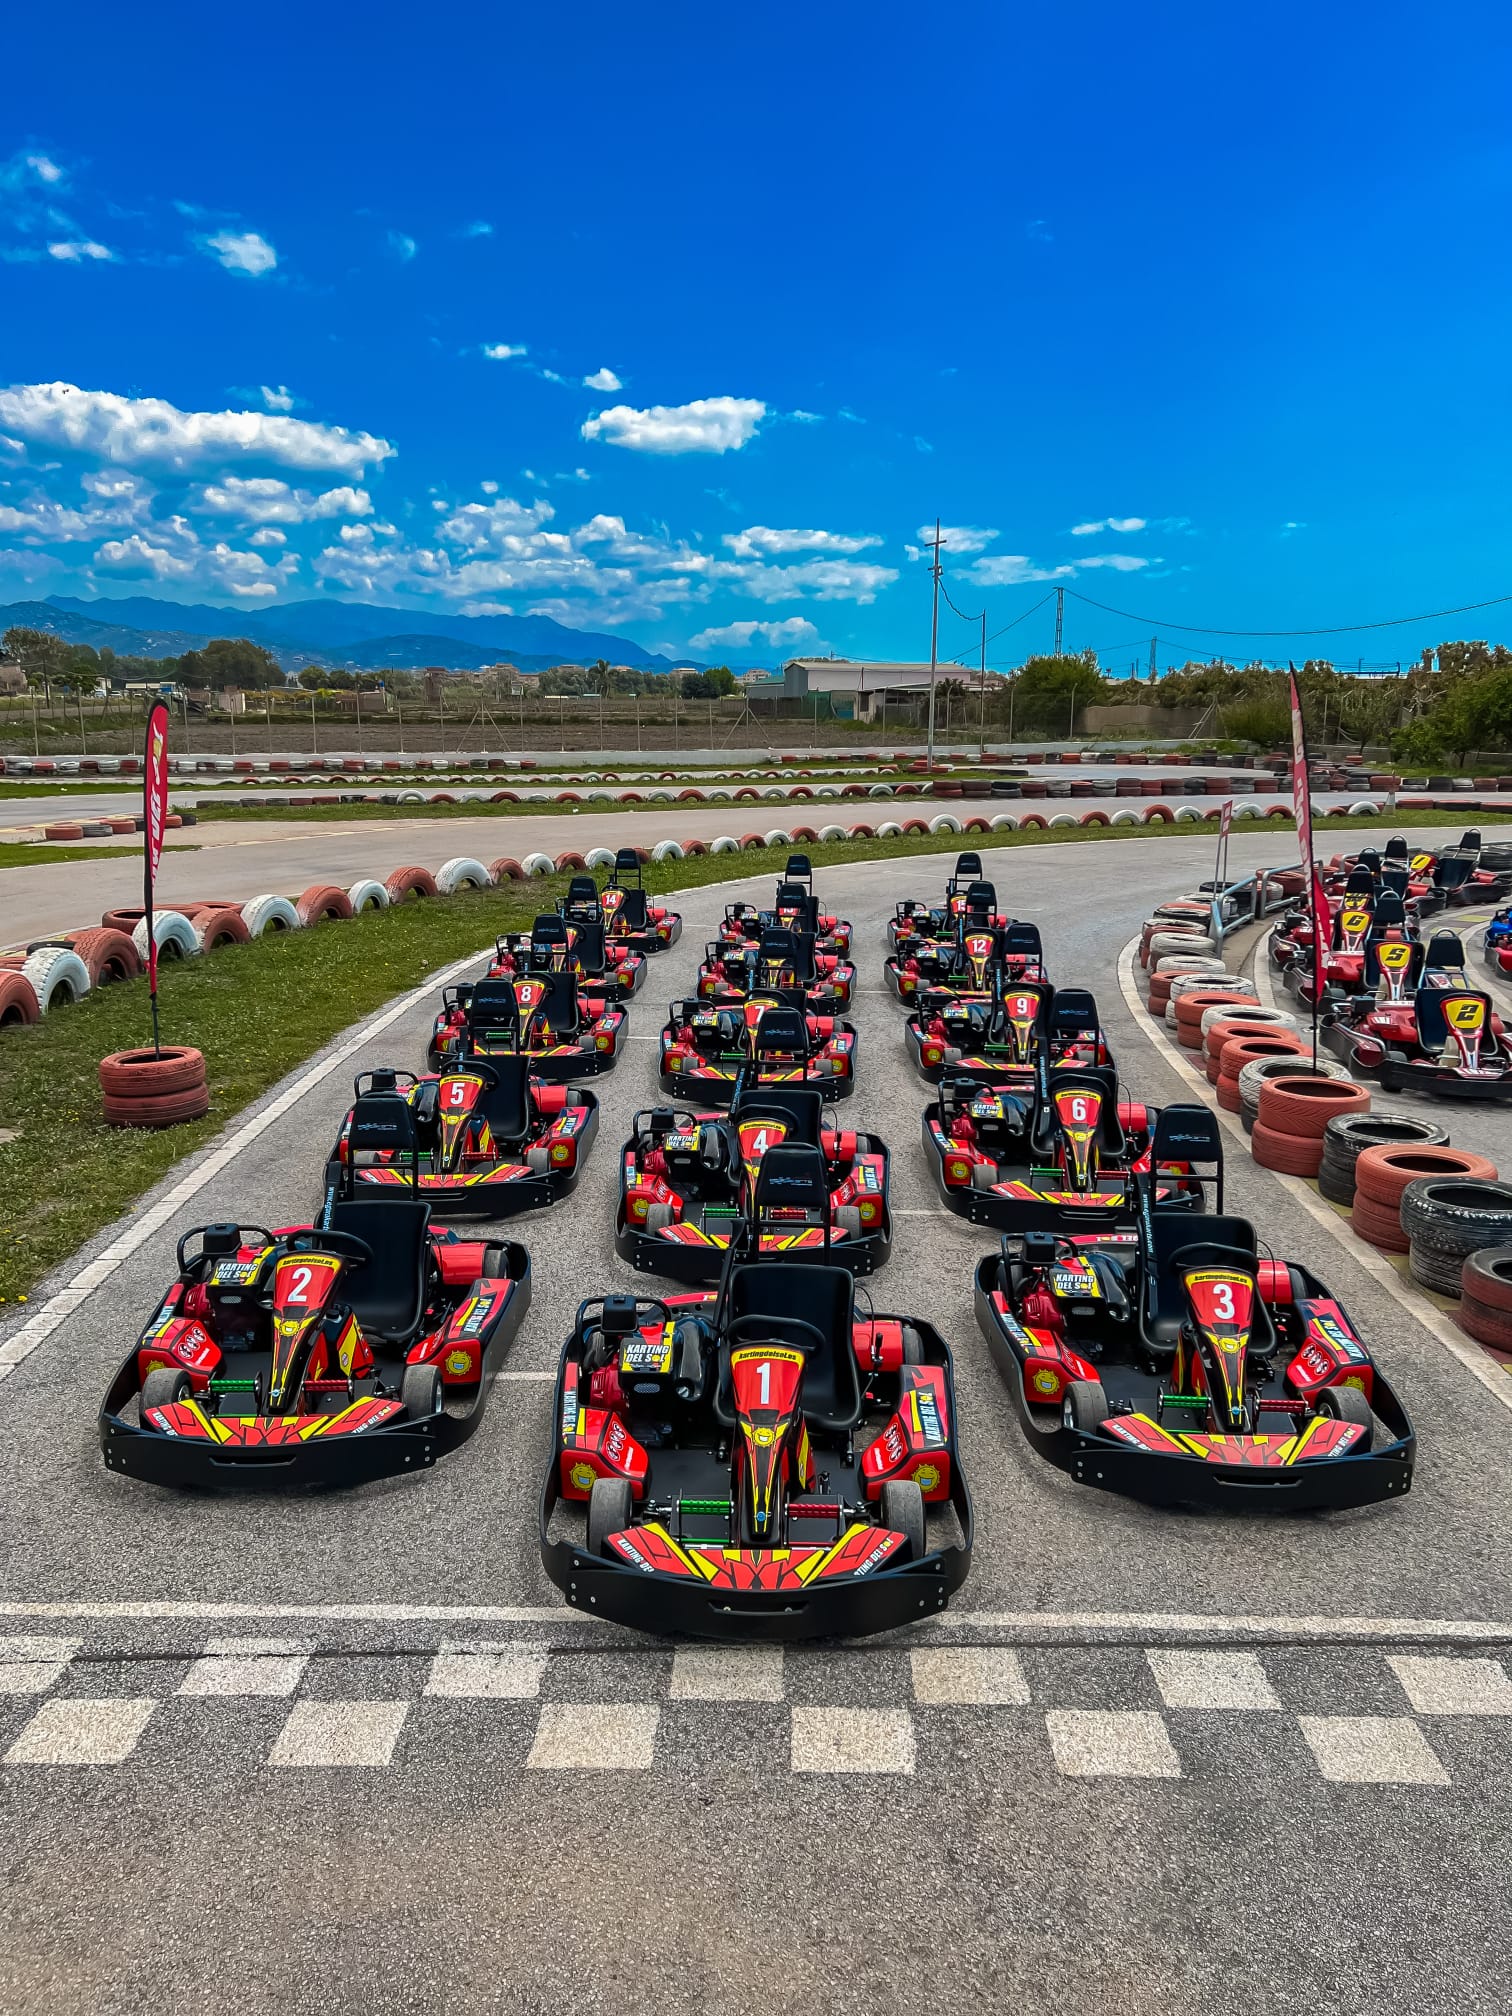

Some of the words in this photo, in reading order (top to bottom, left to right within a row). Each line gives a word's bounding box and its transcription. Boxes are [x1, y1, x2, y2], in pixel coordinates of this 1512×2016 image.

[605, 894, 617, 905] 14
[972, 939, 987, 953] 12
[1385, 948, 1406, 961] 5
[520, 985, 532, 1002] 8
[1016, 997, 1028, 1014] 9
[1456, 1004, 1479, 1022] 2
[754, 1005, 765, 1023] 7
[450, 1082, 465, 1105] 5
[1071, 1098, 1087, 1121] 6
[752, 1130, 769, 1154] 4
[216, 1270, 235, 1279] DEL
[218, 1262, 257, 1272] KARTING
[287, 1267, 312, 1302] 2
[1056, 1273, 1094, 1283] KARTING
[1057, 1281, 1073, 1290] DEL
[1213, 1283, 1235, 1320] 3
[627, 1344, 669, 1354] KARTING
[739, 1350, 797, 1360] kartingdelsol.es
[625, 1353, 643, 1362] DEL
[756, 1362, 770, 1405] 1
[616, 1538, 644, 1564] KARTING
[869, 1548, 884, 1562] DEL
